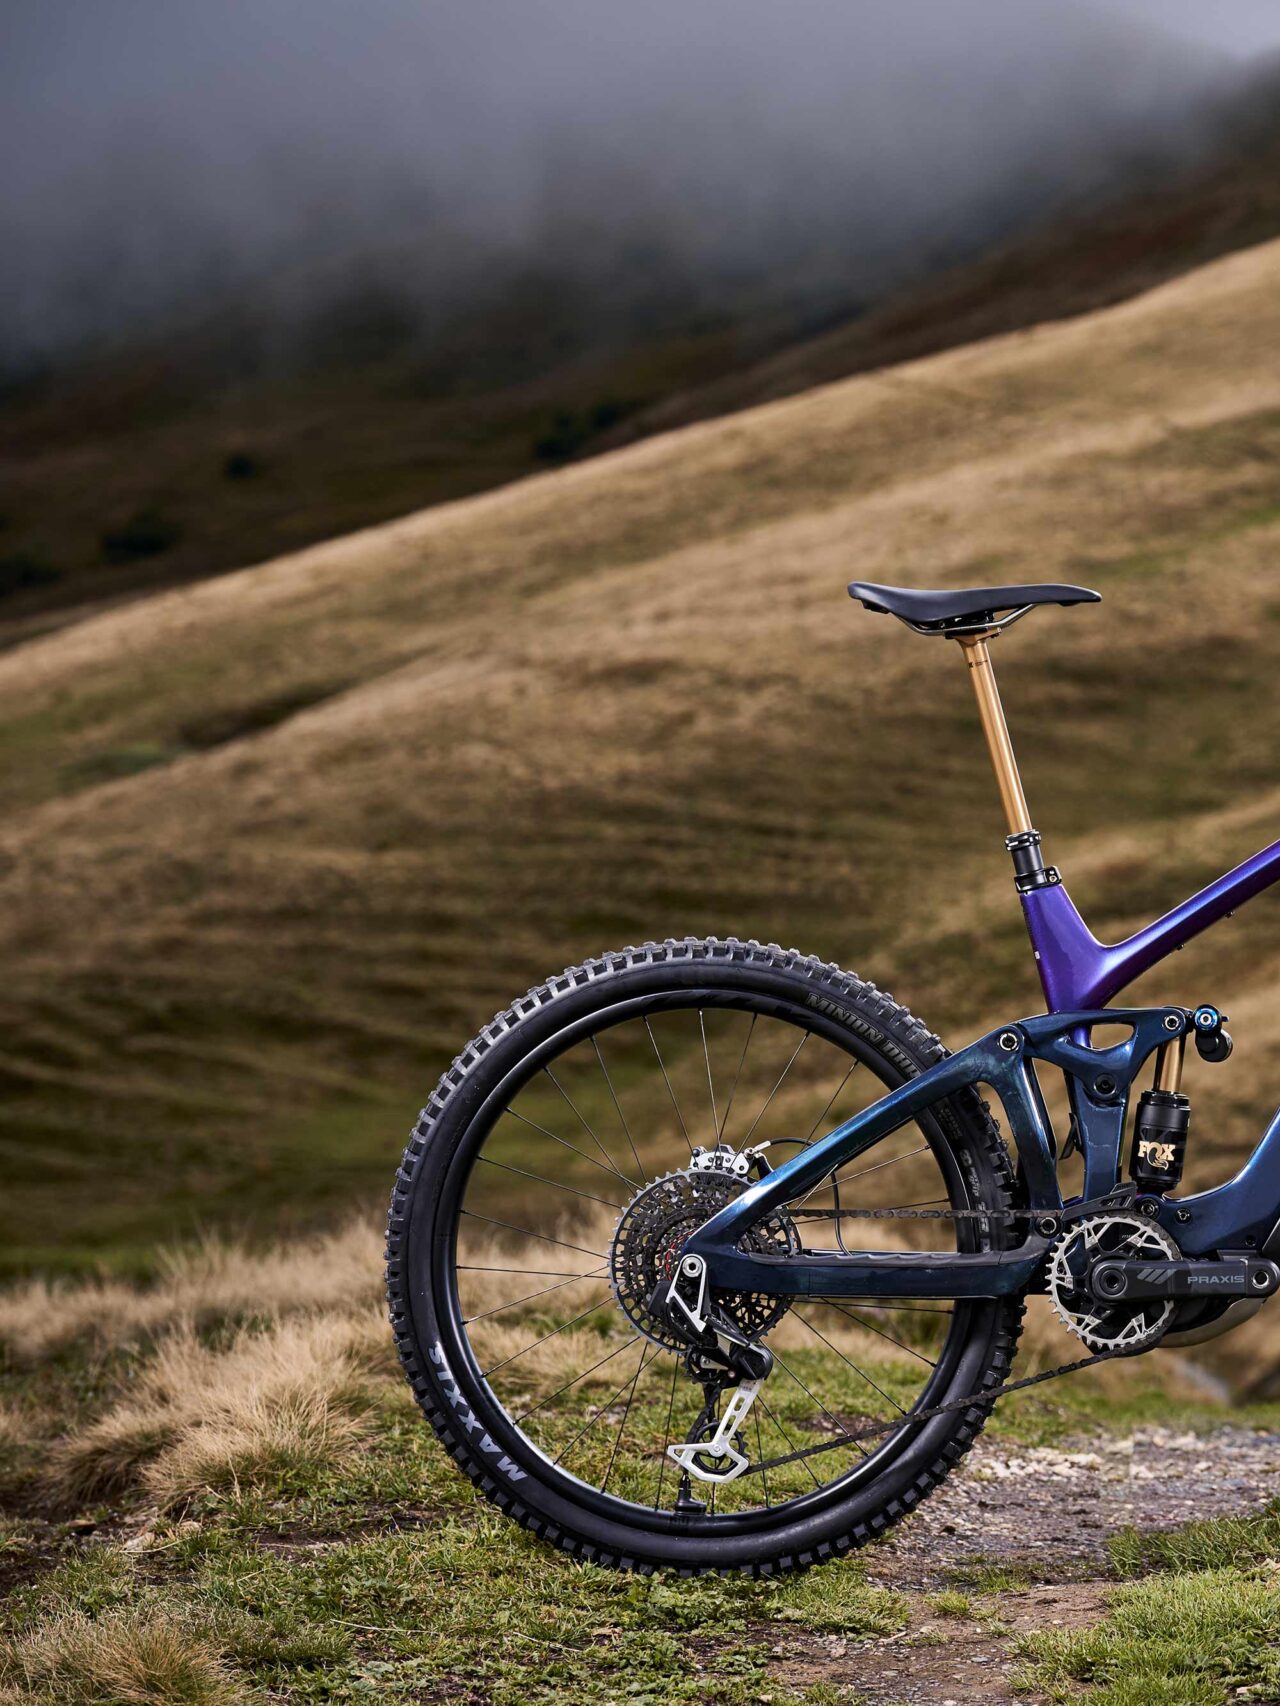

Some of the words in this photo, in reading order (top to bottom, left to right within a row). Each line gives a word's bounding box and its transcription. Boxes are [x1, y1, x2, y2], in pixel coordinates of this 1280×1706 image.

[806, 993, 884, 1044] MINION
[1138, 1141, 1176, 1170] FOX
[1187, 1275, 1245, 1285] PRAXIS
[428, 1340, 529, 1482] MAXXIS
